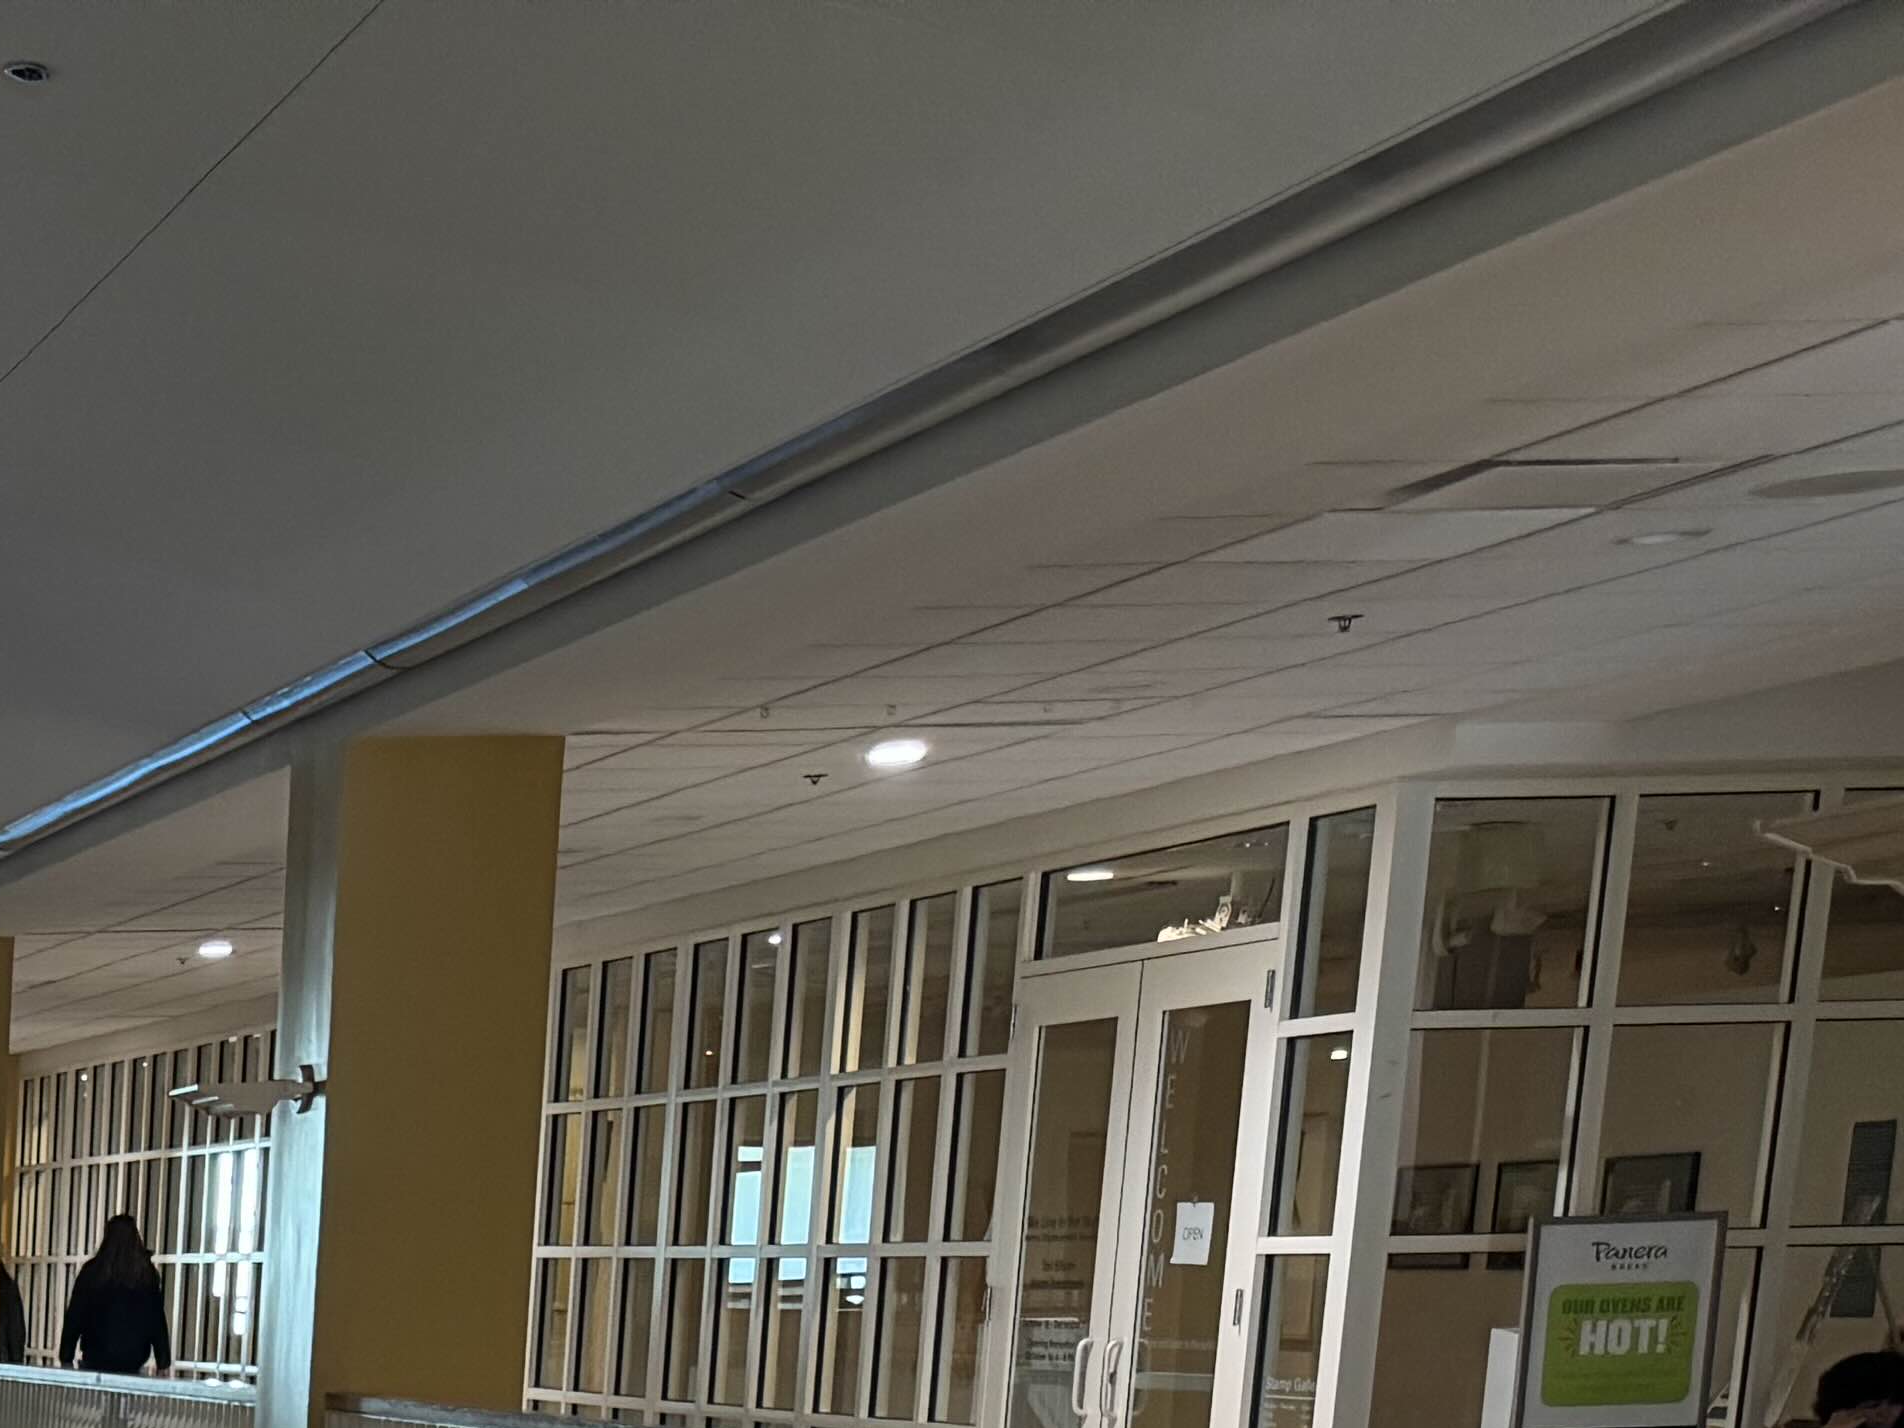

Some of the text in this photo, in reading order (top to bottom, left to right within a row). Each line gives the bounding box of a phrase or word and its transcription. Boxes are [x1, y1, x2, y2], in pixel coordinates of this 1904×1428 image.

[1182, 1226, 1205, 1241] OPEN
[1591, 1241, 1668, 1262] Panera
[1562, 1295, 1686, 1314] OUR OVENS ARE
[1579, 1318, 1669, 1355] HOT!
